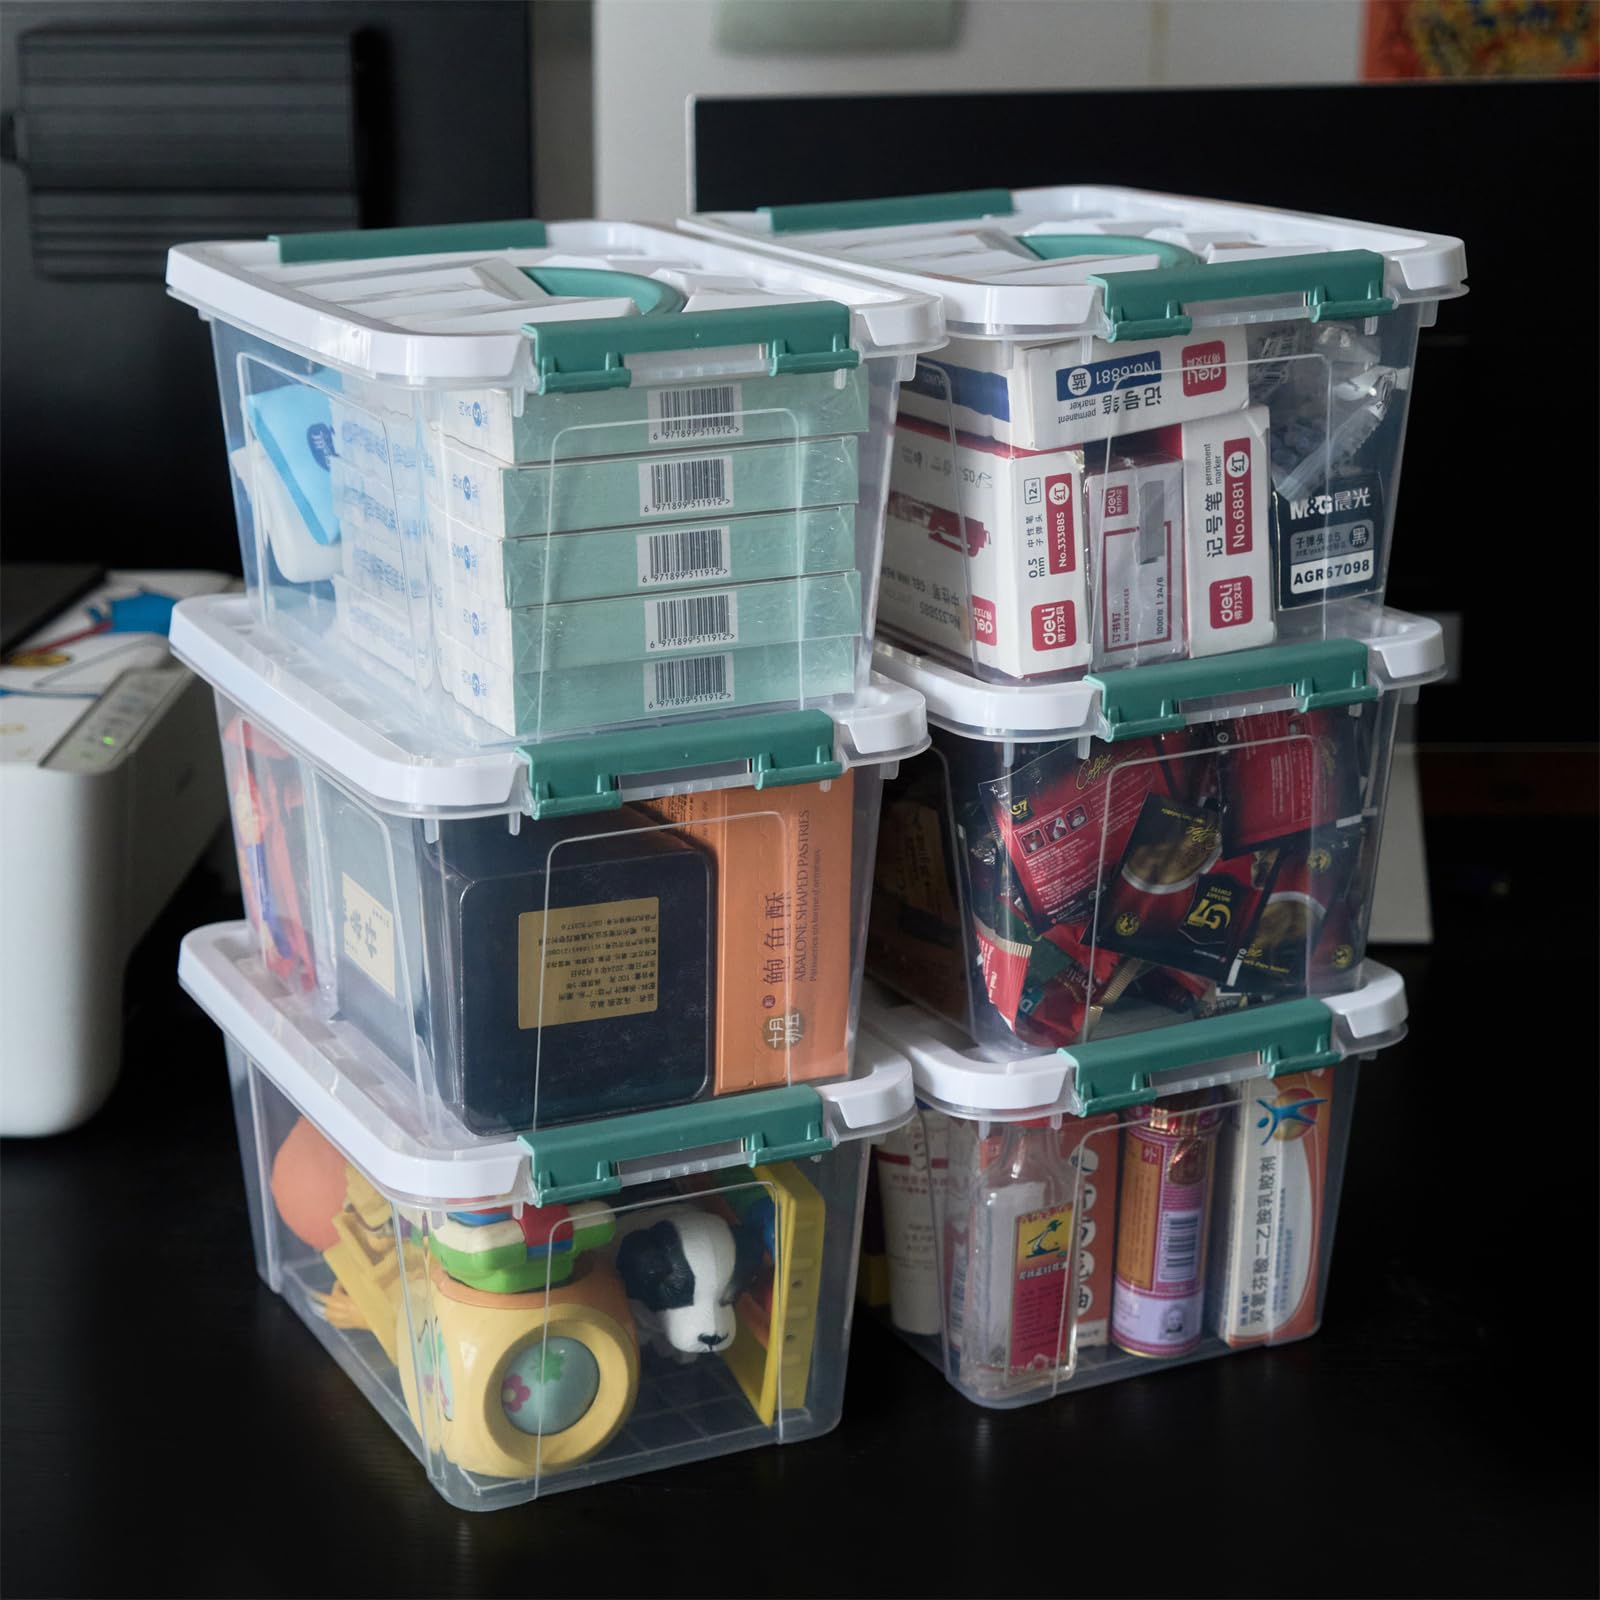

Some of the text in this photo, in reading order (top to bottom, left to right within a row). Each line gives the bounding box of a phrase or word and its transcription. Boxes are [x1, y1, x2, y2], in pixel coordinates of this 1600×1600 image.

[1072, 361, 1155, 390] No.6881 蓝
[1058, 408, 1097, 424] permanent
[1070, 398, 1096, 410] marker
[1102, 386, 1161, 415] 记号笔
[1204, 444, 1213, 486] permanent
[1213, 456, 1222, 484] marker
[1108, 489, 1116, 514] deli
[1231, 455, 1246, 547] No.6881 红
[1290, 487, 1371, 520] M&G 晨光
[1025, 515, 1035, 548] 中性笔
[1035, 514, 1044, 546] 子弹头
[1053, 487, 1067, 567] No.33388S 红
[1205, 492, 1223, 558] 记号笔
[1352, 527, 1366, 545] 黑
[1028, 558, 1038, 578] 0.5
[1038, 557, 1045, 576] mm
[1294, 559, 1370, 585] AGR67098
[1219, 583, 1233, 622] deli
[1233, 582, 1243, 620] 得力文具
[1041, 607, 1057, 645] deli
[1056, 606, 1066, 643] 得力文具
[1112, 612, 1121, 643] 订书钉
[795, 810, 809, 982] ABALONE SHAPED PASTRIES
[763, 892, 791, 984] 鲍鱼酥
